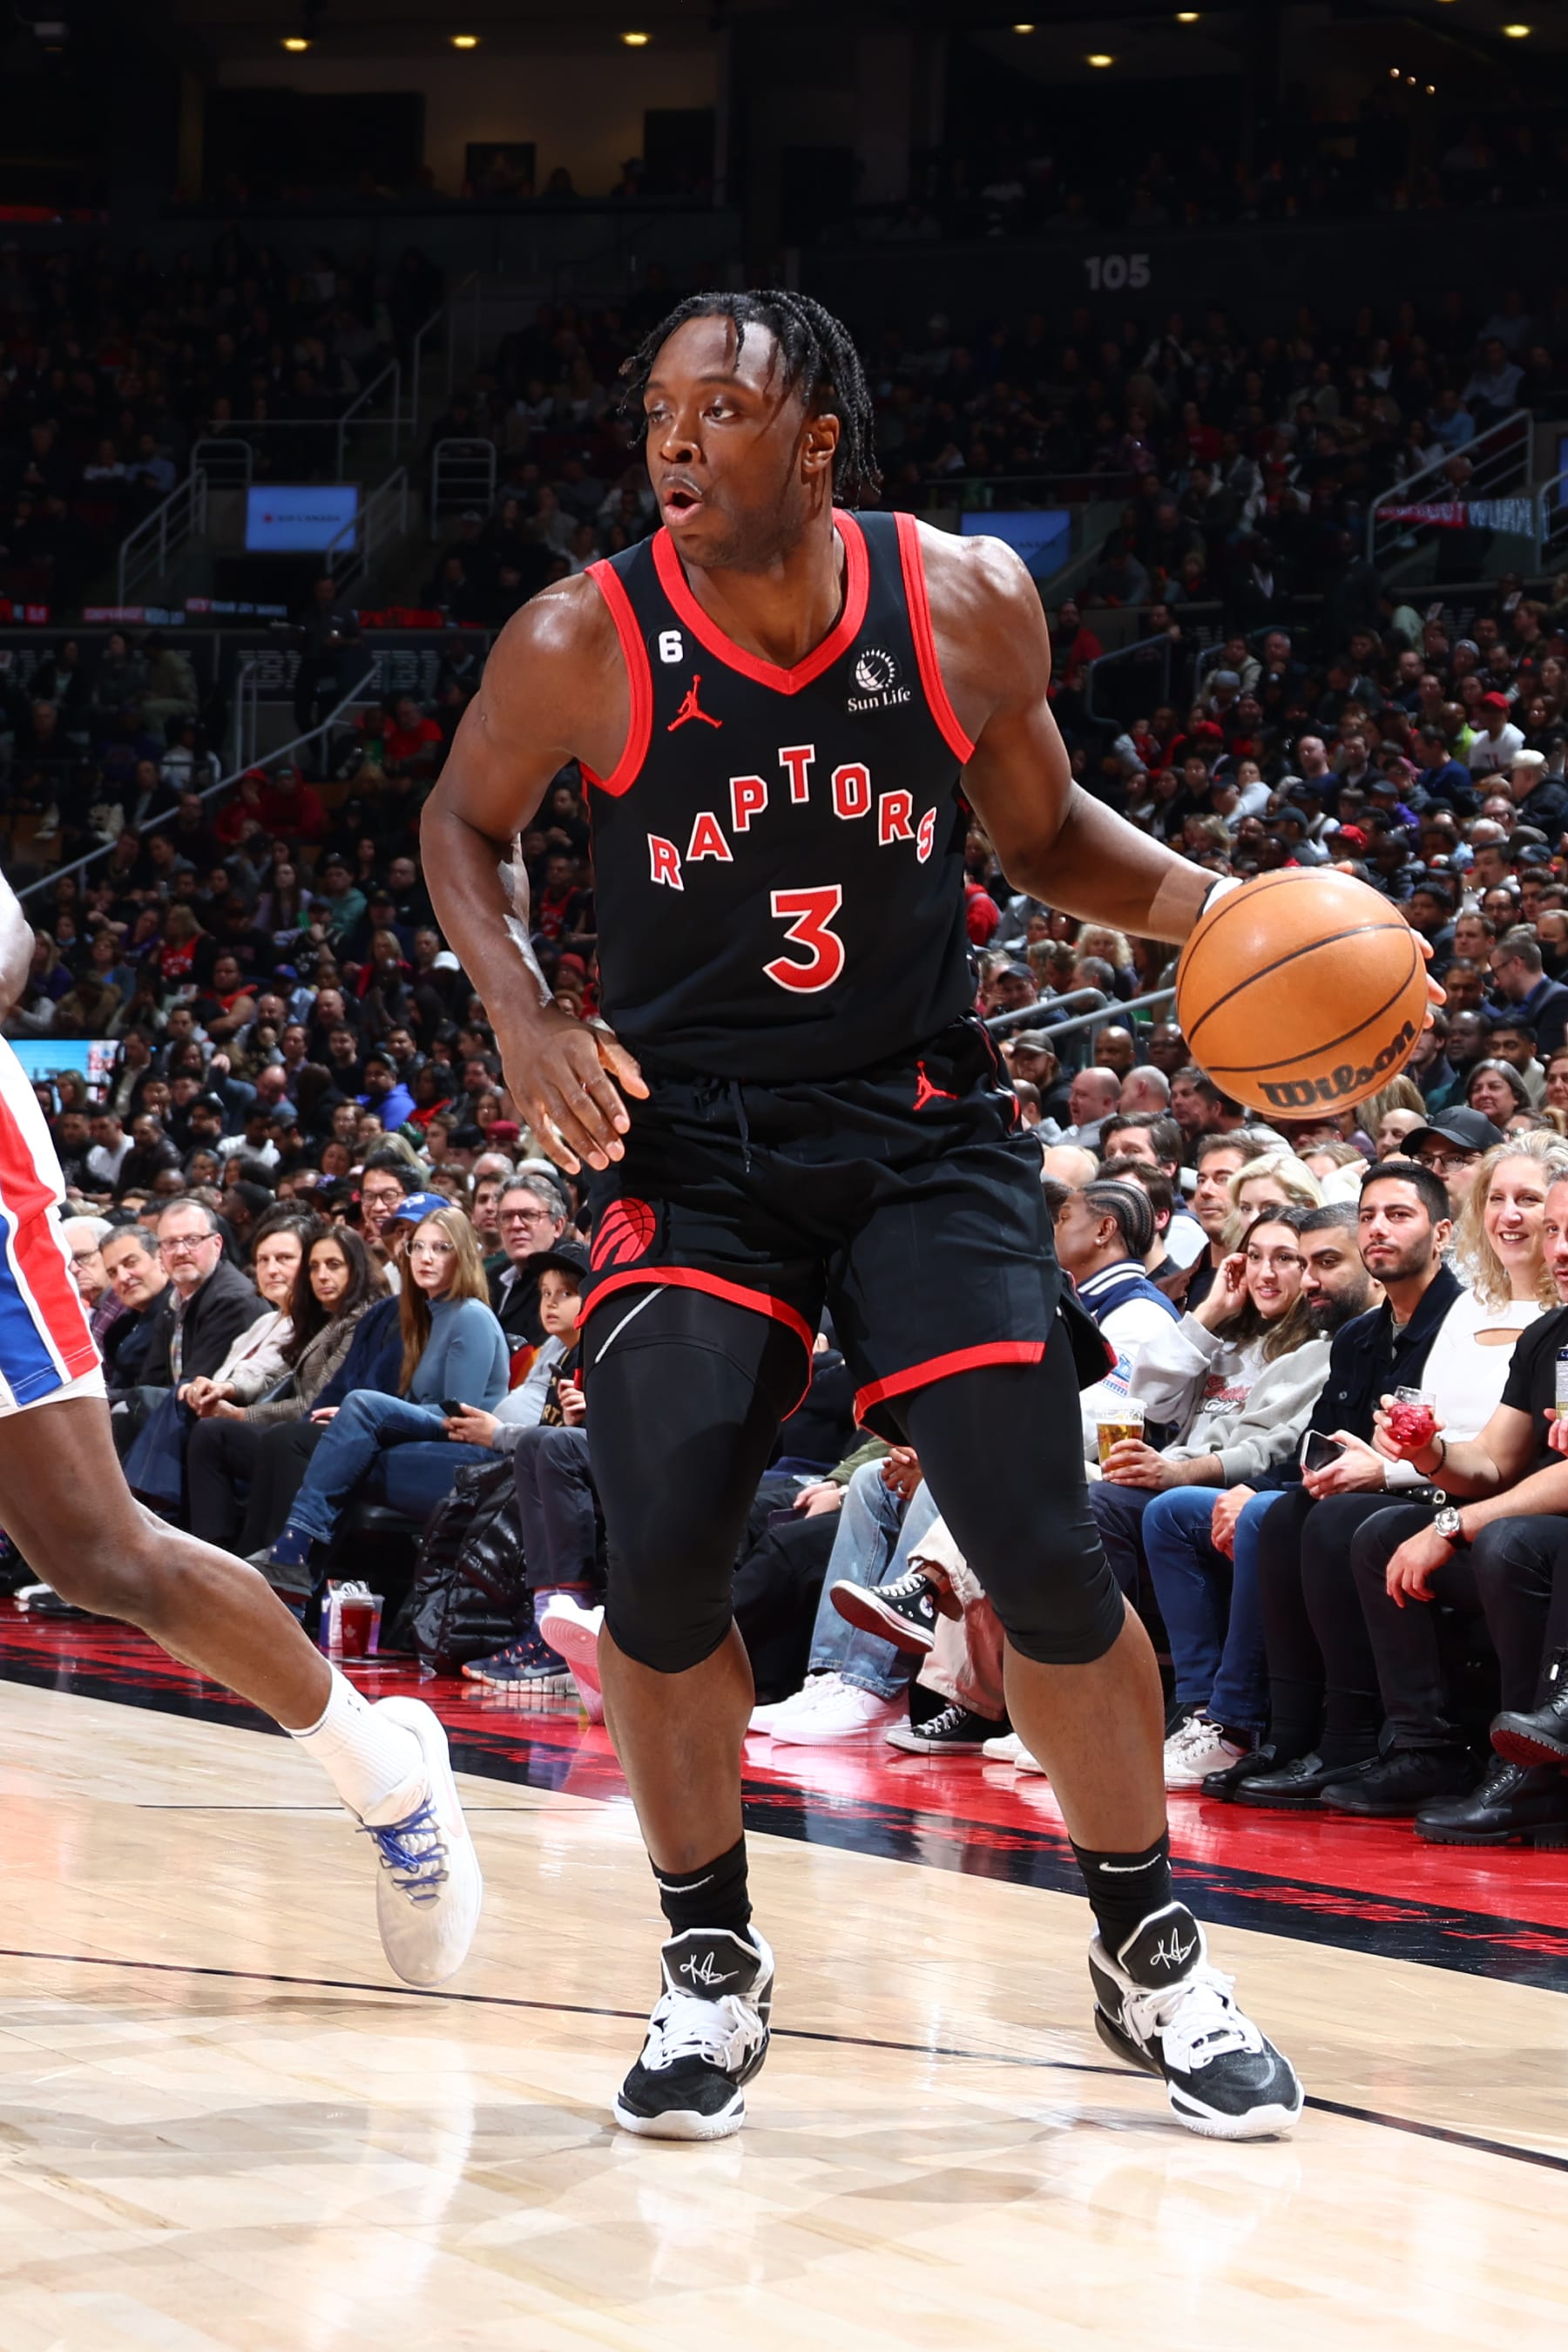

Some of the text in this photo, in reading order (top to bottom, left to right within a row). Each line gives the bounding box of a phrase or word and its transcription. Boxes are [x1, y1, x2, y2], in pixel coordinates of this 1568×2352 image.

[1084, 253, 1151, 290] 105
[658, 630, 684, 663] 6
[848, 686, 911, 712] Sun Life
[647, 744, 936, 891] RAPTORS
[762, 883, 845, 993] 3
[1257, 1020, 1416, 1108] Wilson
